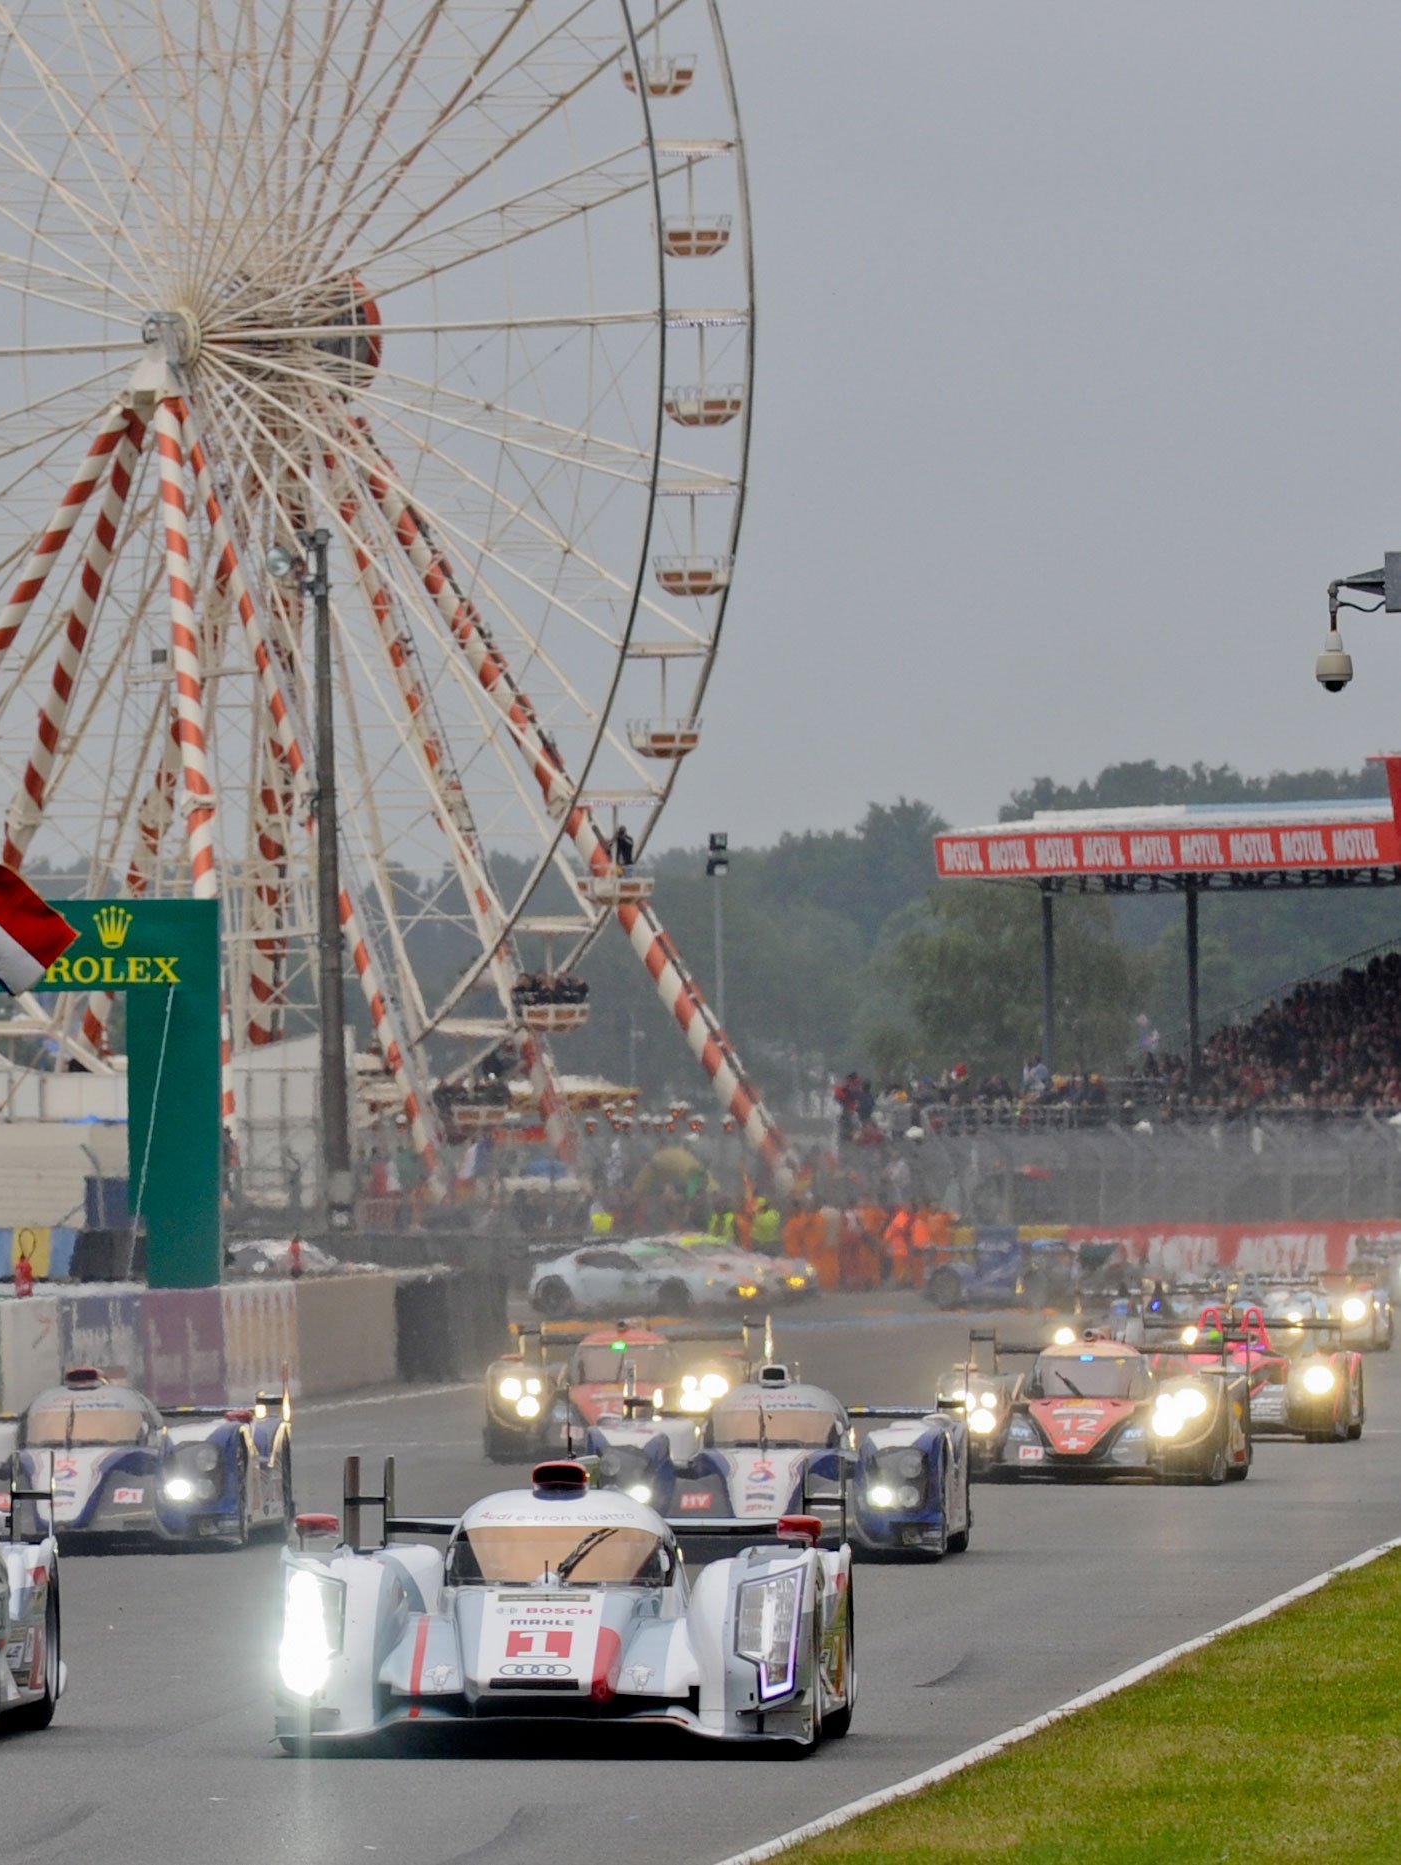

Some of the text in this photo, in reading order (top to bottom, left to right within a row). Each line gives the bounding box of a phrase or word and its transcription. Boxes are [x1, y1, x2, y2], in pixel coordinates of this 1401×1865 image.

[1035, 837, 1078, 868] MOTUL
[1082, 836, 1126, 867] MOTUL
[1130, 835, 1174, 866] MOTUL
[1179, 834, 1224, 865] MOTUL
[1229, 833, 1276, 864] MOTUL
[1279, 830, 1328, 863] MOTUL
[1332, 829, 1380, 861] MOTUL
[44, 956, 181, 984] ROLEX
[1057, 1418, 1098, 1432] 12
[1021, 1448, 1040, 1458] P1
[118, 1490, 138, 1500] P1
[478, 1511, 635, 1522] Audi e-tron quattro
[525, 1607, 593, 1615] BOSCH
[516, 1632, 559, 1657] 1
